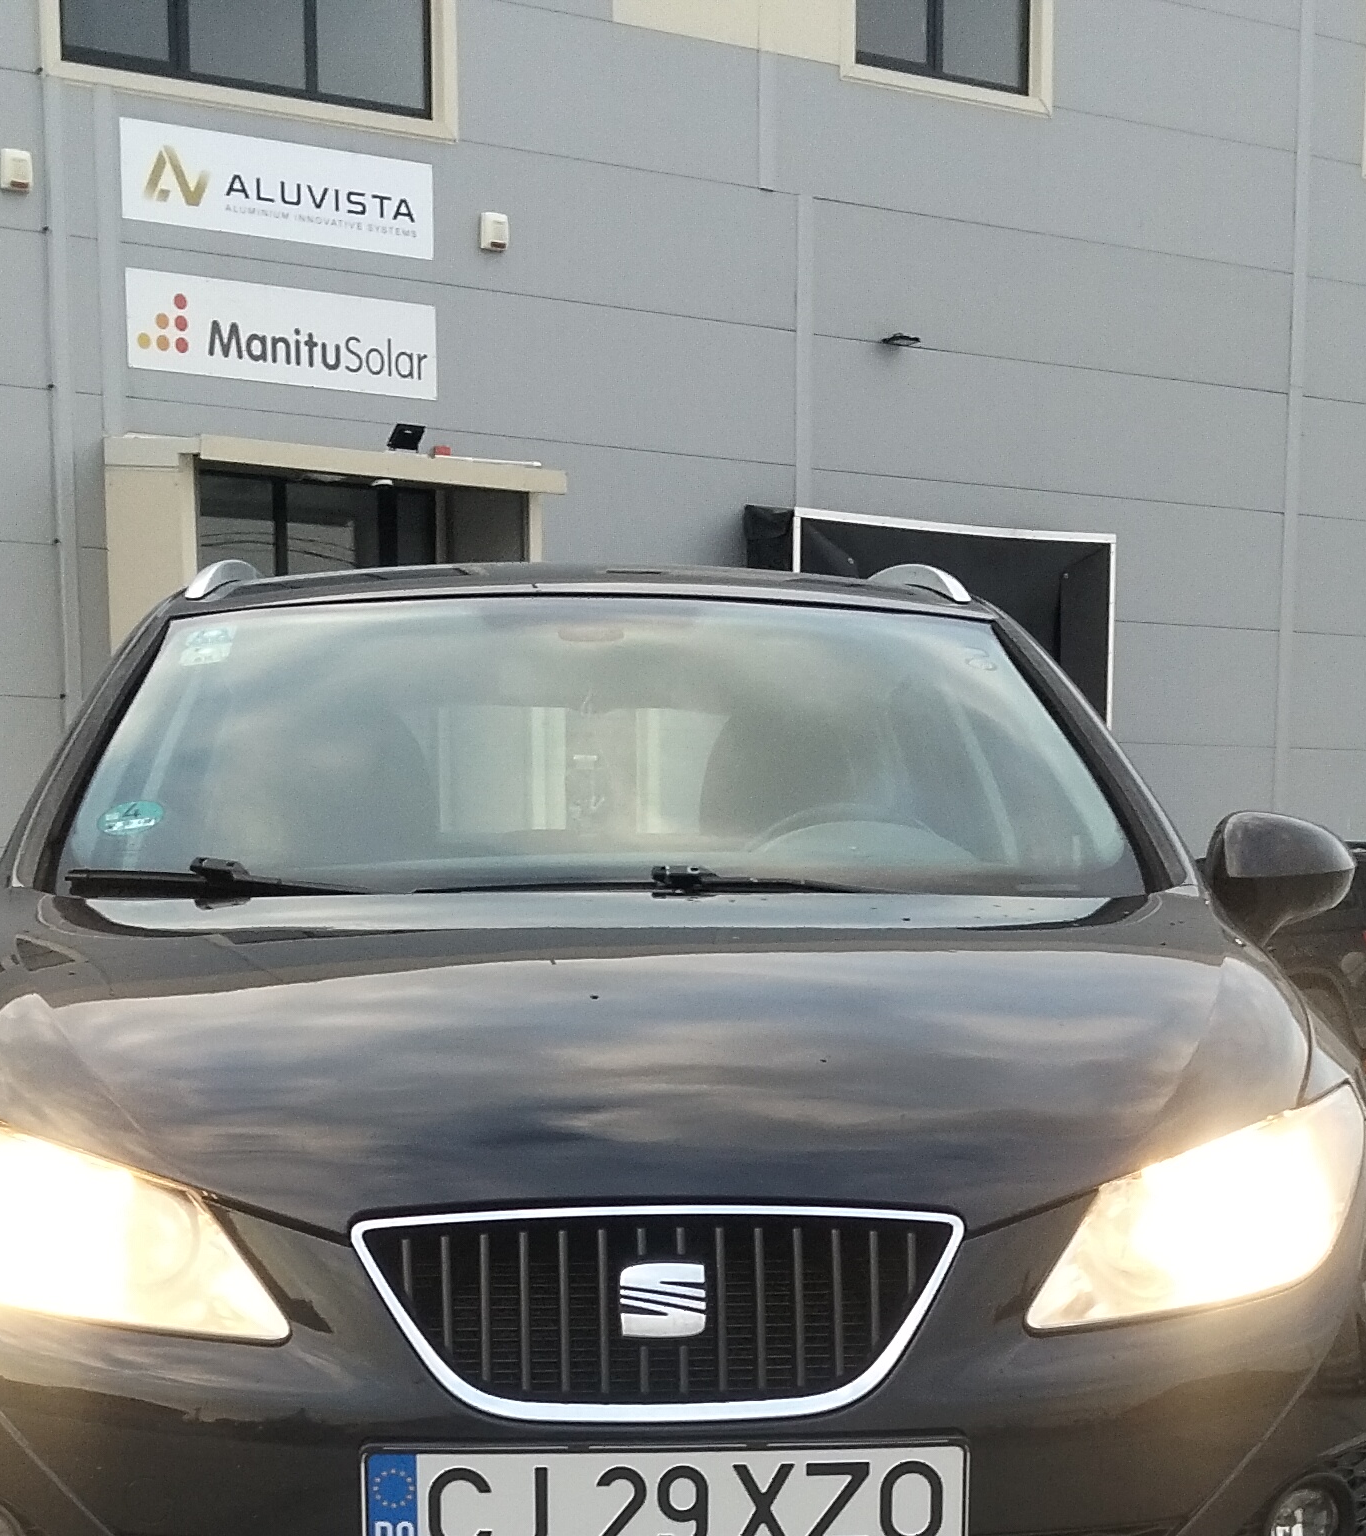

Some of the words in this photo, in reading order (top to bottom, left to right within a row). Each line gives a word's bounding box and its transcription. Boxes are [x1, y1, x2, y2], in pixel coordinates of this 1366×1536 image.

[225, 174, 416, 223] ALUVISTA
[225, 204, 290, 220] ALUMINIUM
[294, 214, 363, 231] INNOVATIVE
[367, 223, 417, 238] SYSTEMS
[208, 319, 428, 381] ManituSolar
[121, 802, 142, 818] 4
